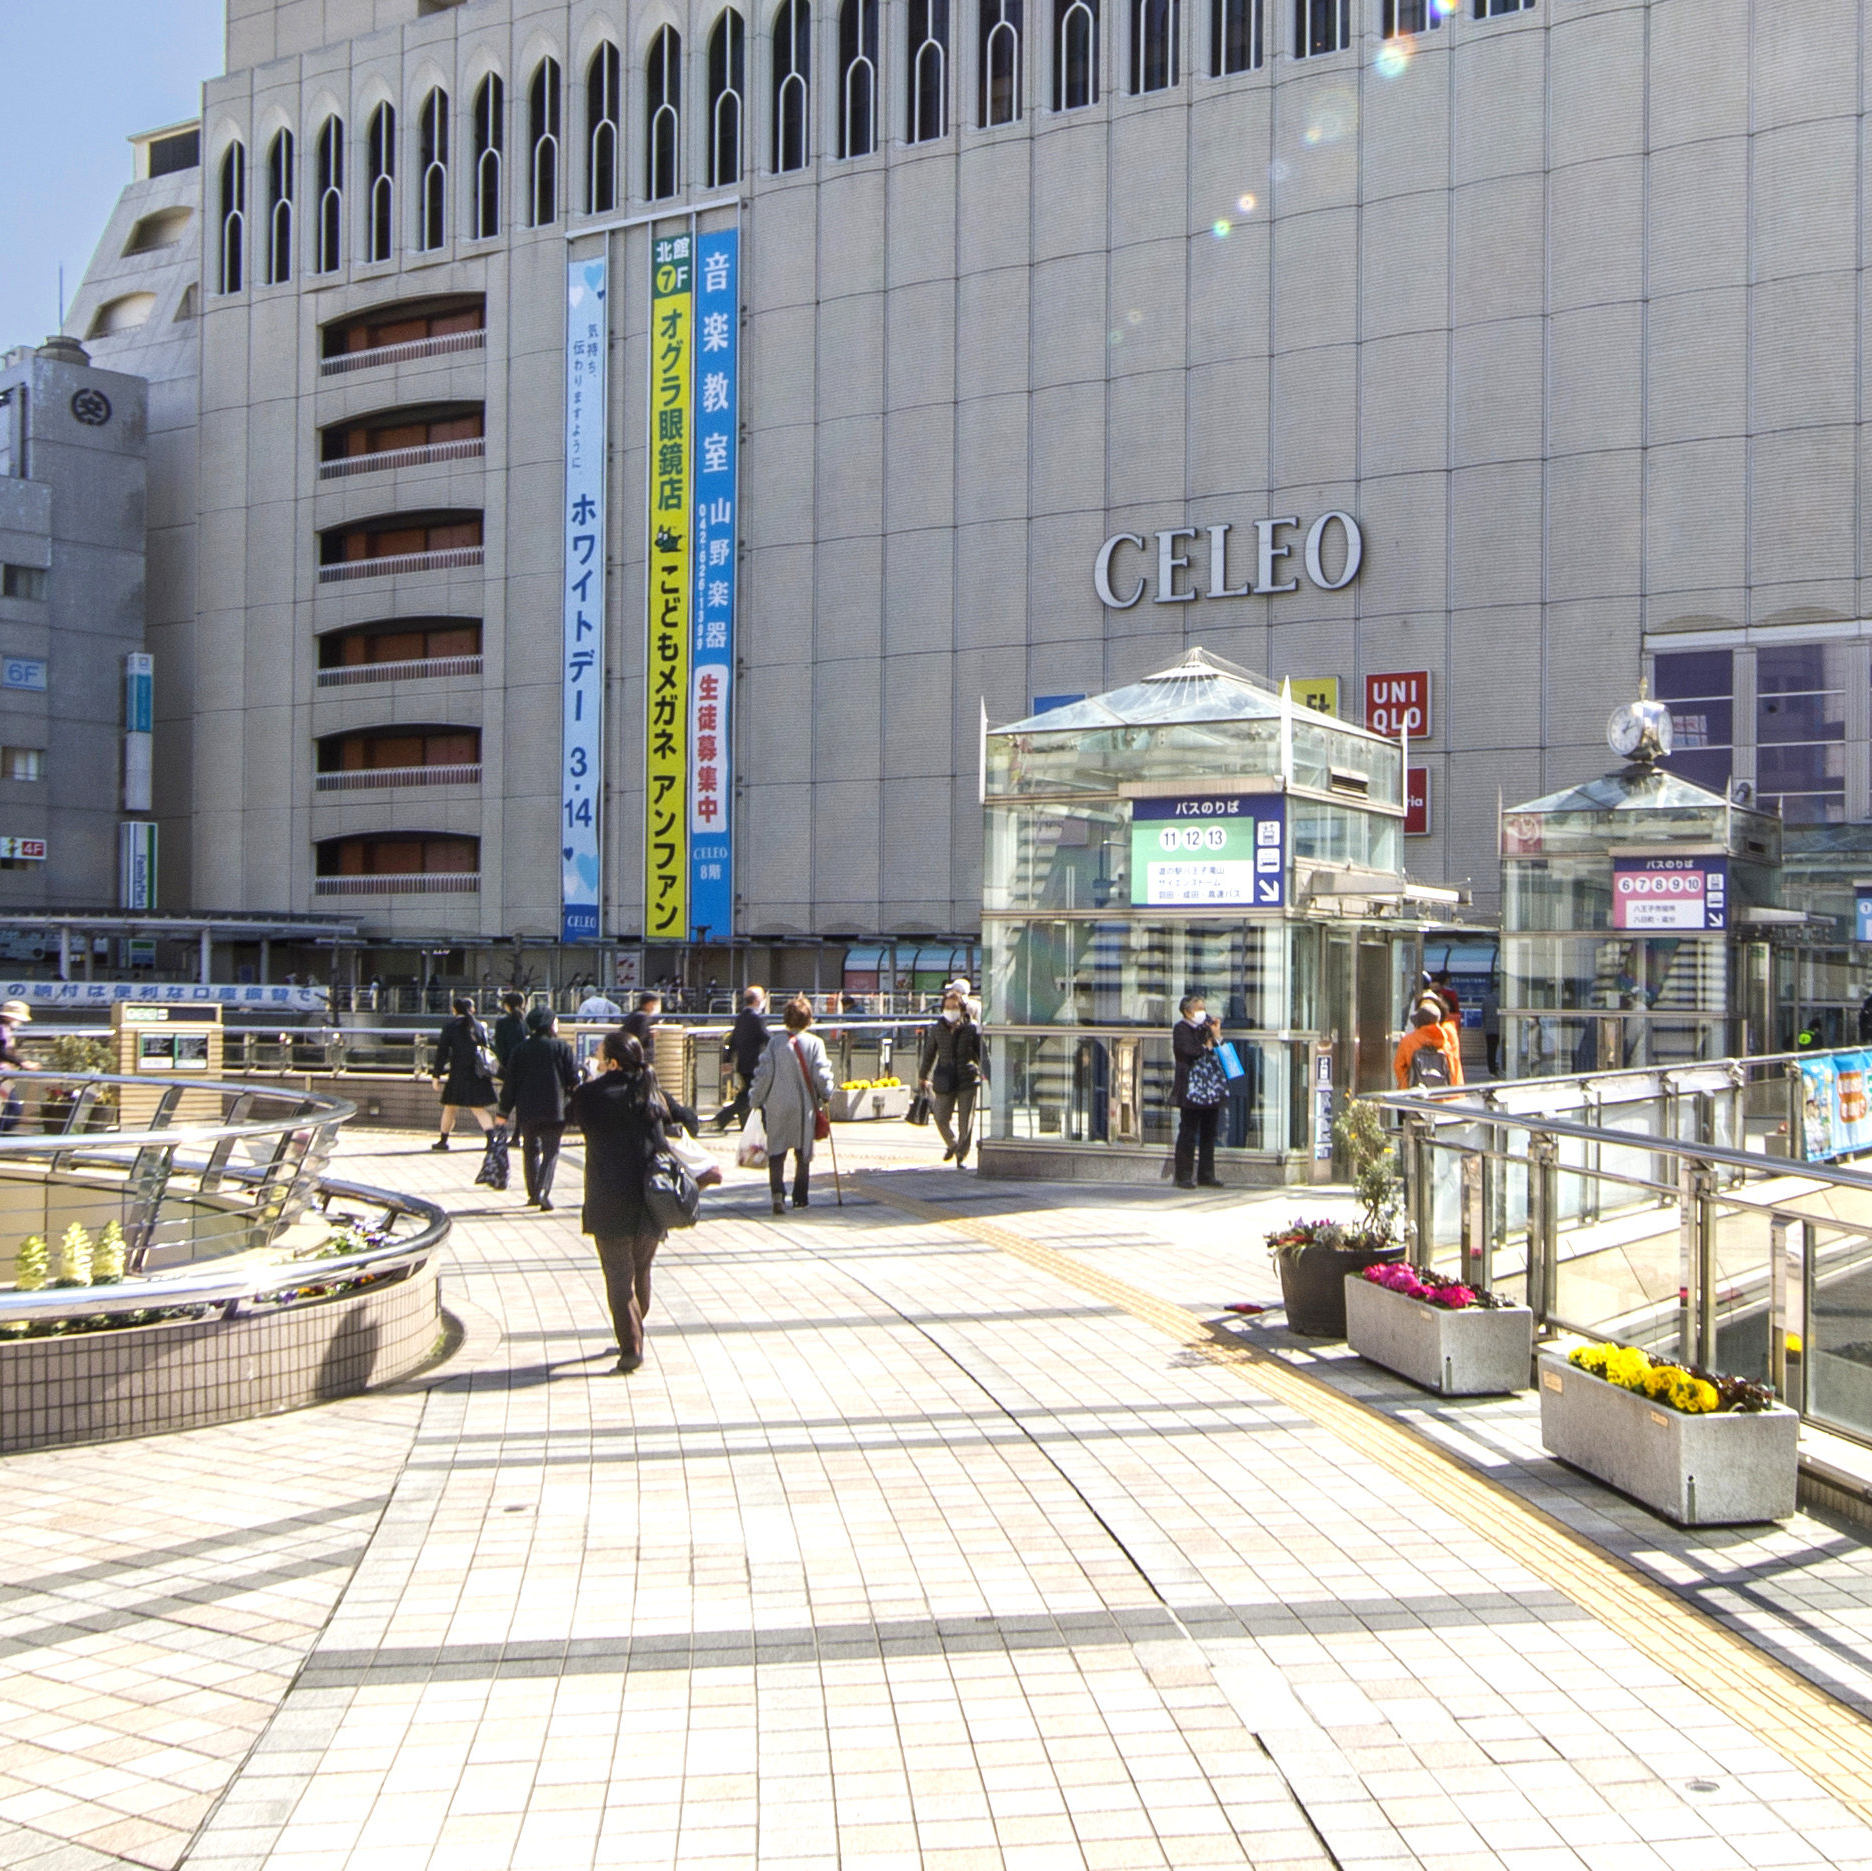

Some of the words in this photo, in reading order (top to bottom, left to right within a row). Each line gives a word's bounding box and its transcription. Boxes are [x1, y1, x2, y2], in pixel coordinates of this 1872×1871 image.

[656, 236, 690, 264] 北館
[659, 265, 689, 292] 7F
[703, 251, 730, 474] 音楽教室
[658, 308, 684, 512] オグラ眼鏡店
[705, 497, 731, 649] 山野楽器
[1093, 510, 1364, 610] CELEO
[569, 493, 597, 722] ホワイトデー
[8, 663, 40, 682] 6F
[652, 565, 681, 760] こどもメガネ
[1372, 680, 1417, 704] UNI
[1372, 707, 1421, 734] QLO
[697, 674, 719, 823] 生徒募集中
[1175, 800, 1240, 815] バスのりば
[23, 843, 42, 856] 4F
[652, 775, 678, 931] アンファン
[693, 847, 728, 860] CELEO
[700, 865, 722, 880] 8階
[1646, 859, 1694, 869] バスのりば
[135, 853, 147, 909] FamilyMart
[567, 915, 597, 928] CELEO
